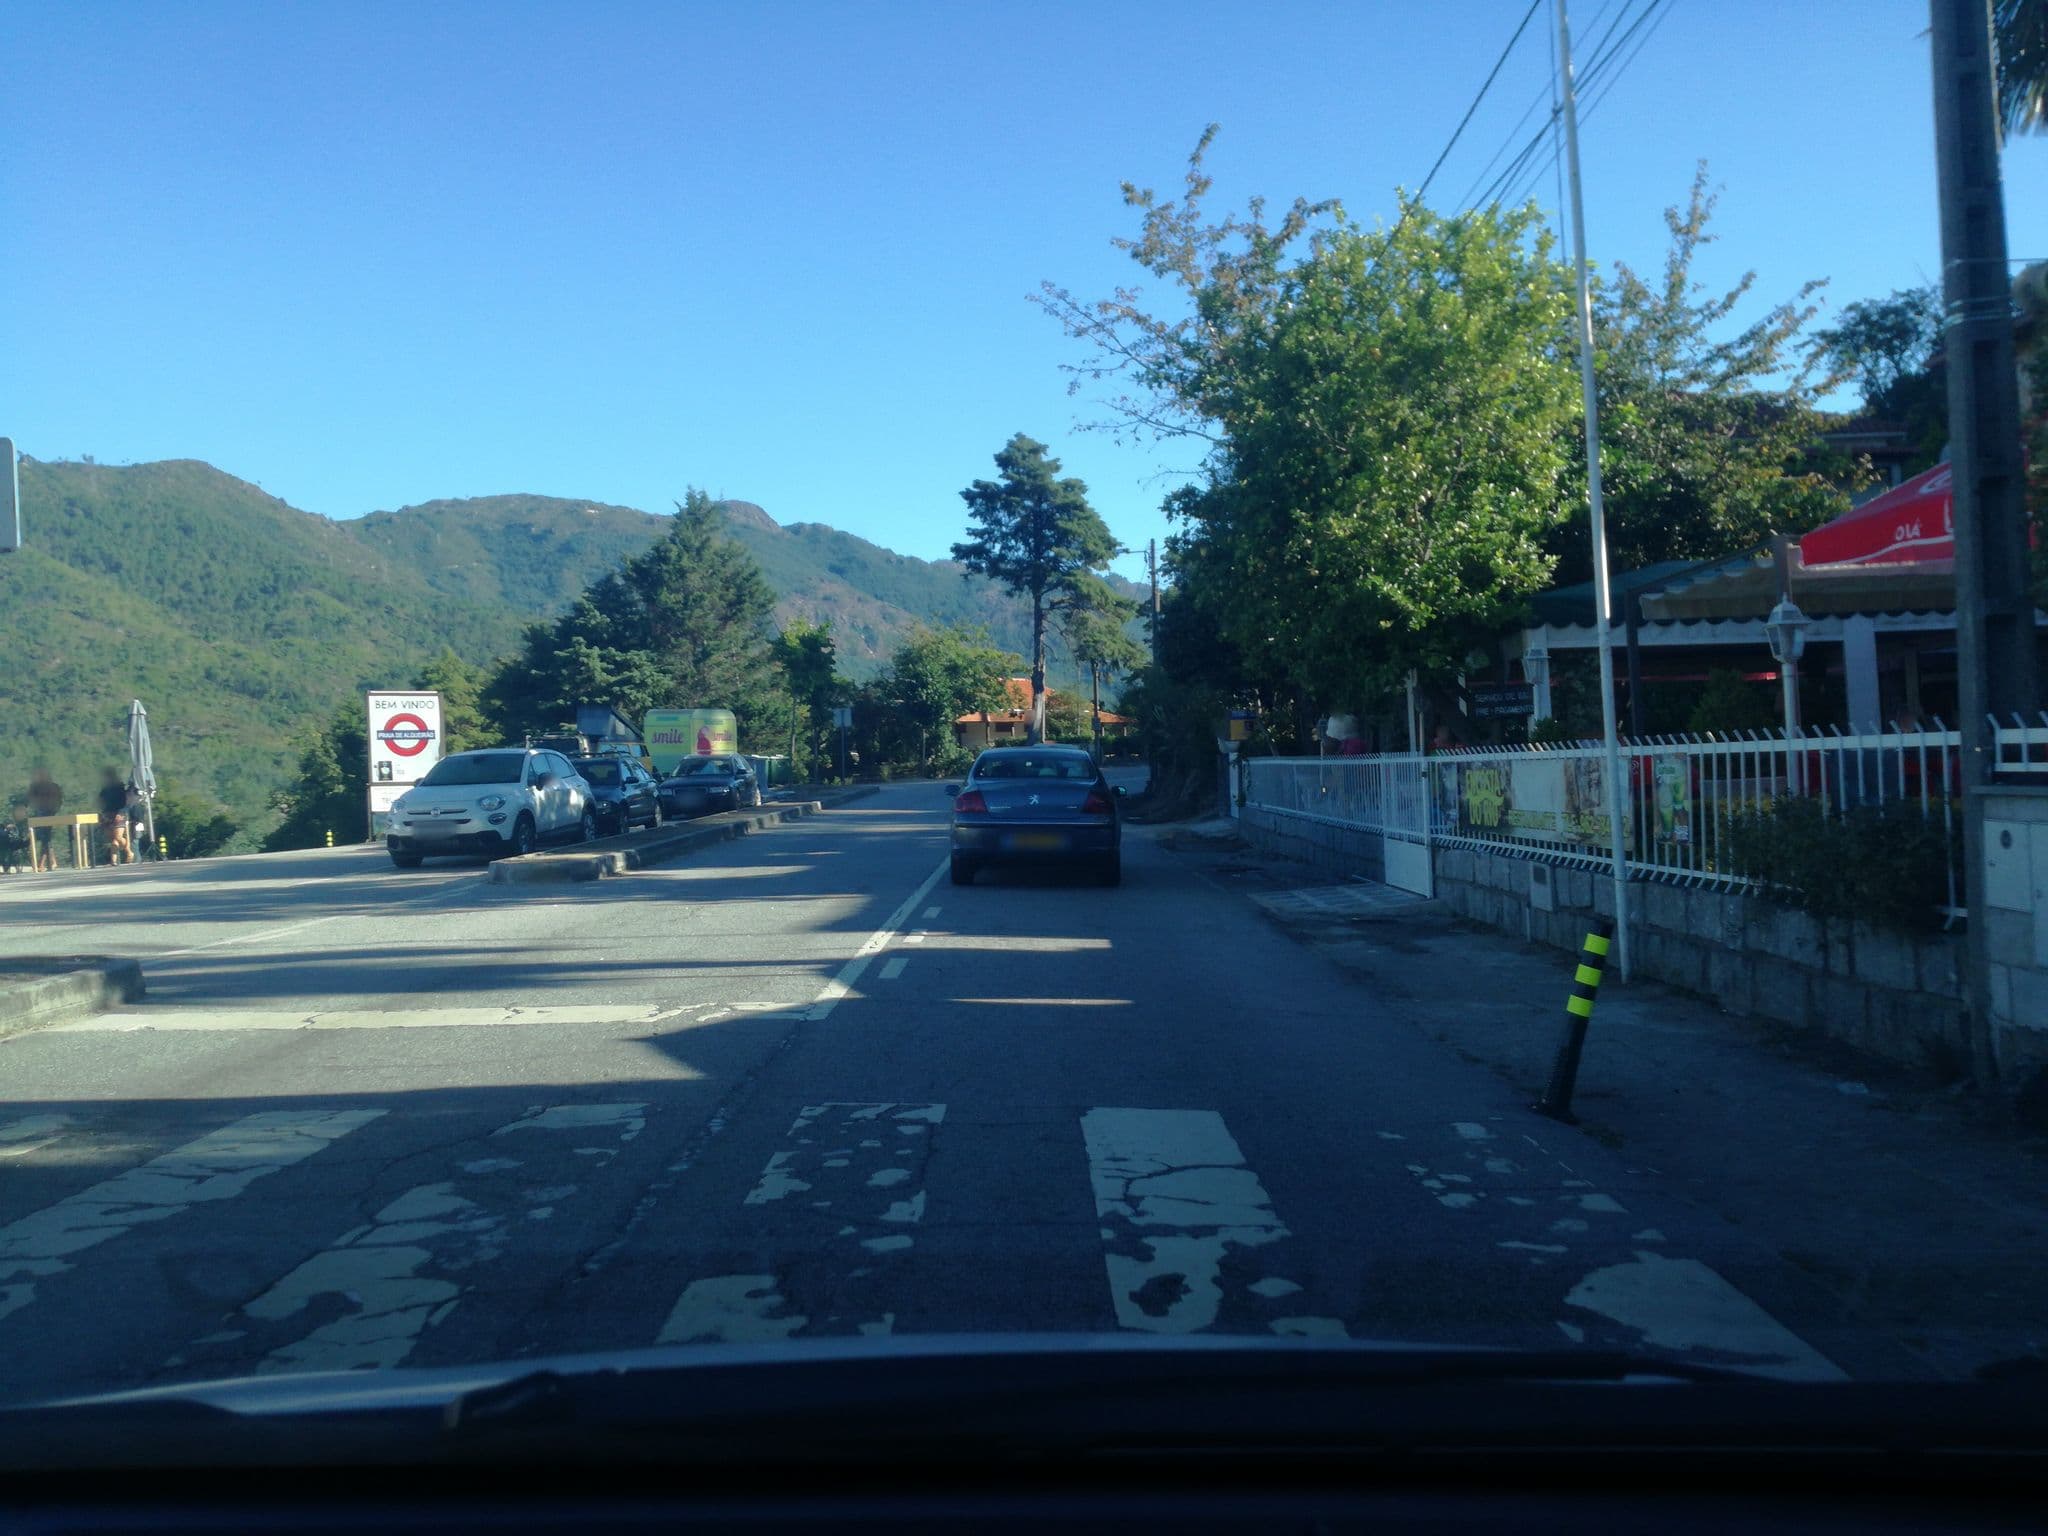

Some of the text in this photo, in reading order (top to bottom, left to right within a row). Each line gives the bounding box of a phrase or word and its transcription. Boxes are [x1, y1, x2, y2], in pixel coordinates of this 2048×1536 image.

[375, 700, 435, 709] BEM VINDO
[651, 728, 685, 745] smile
